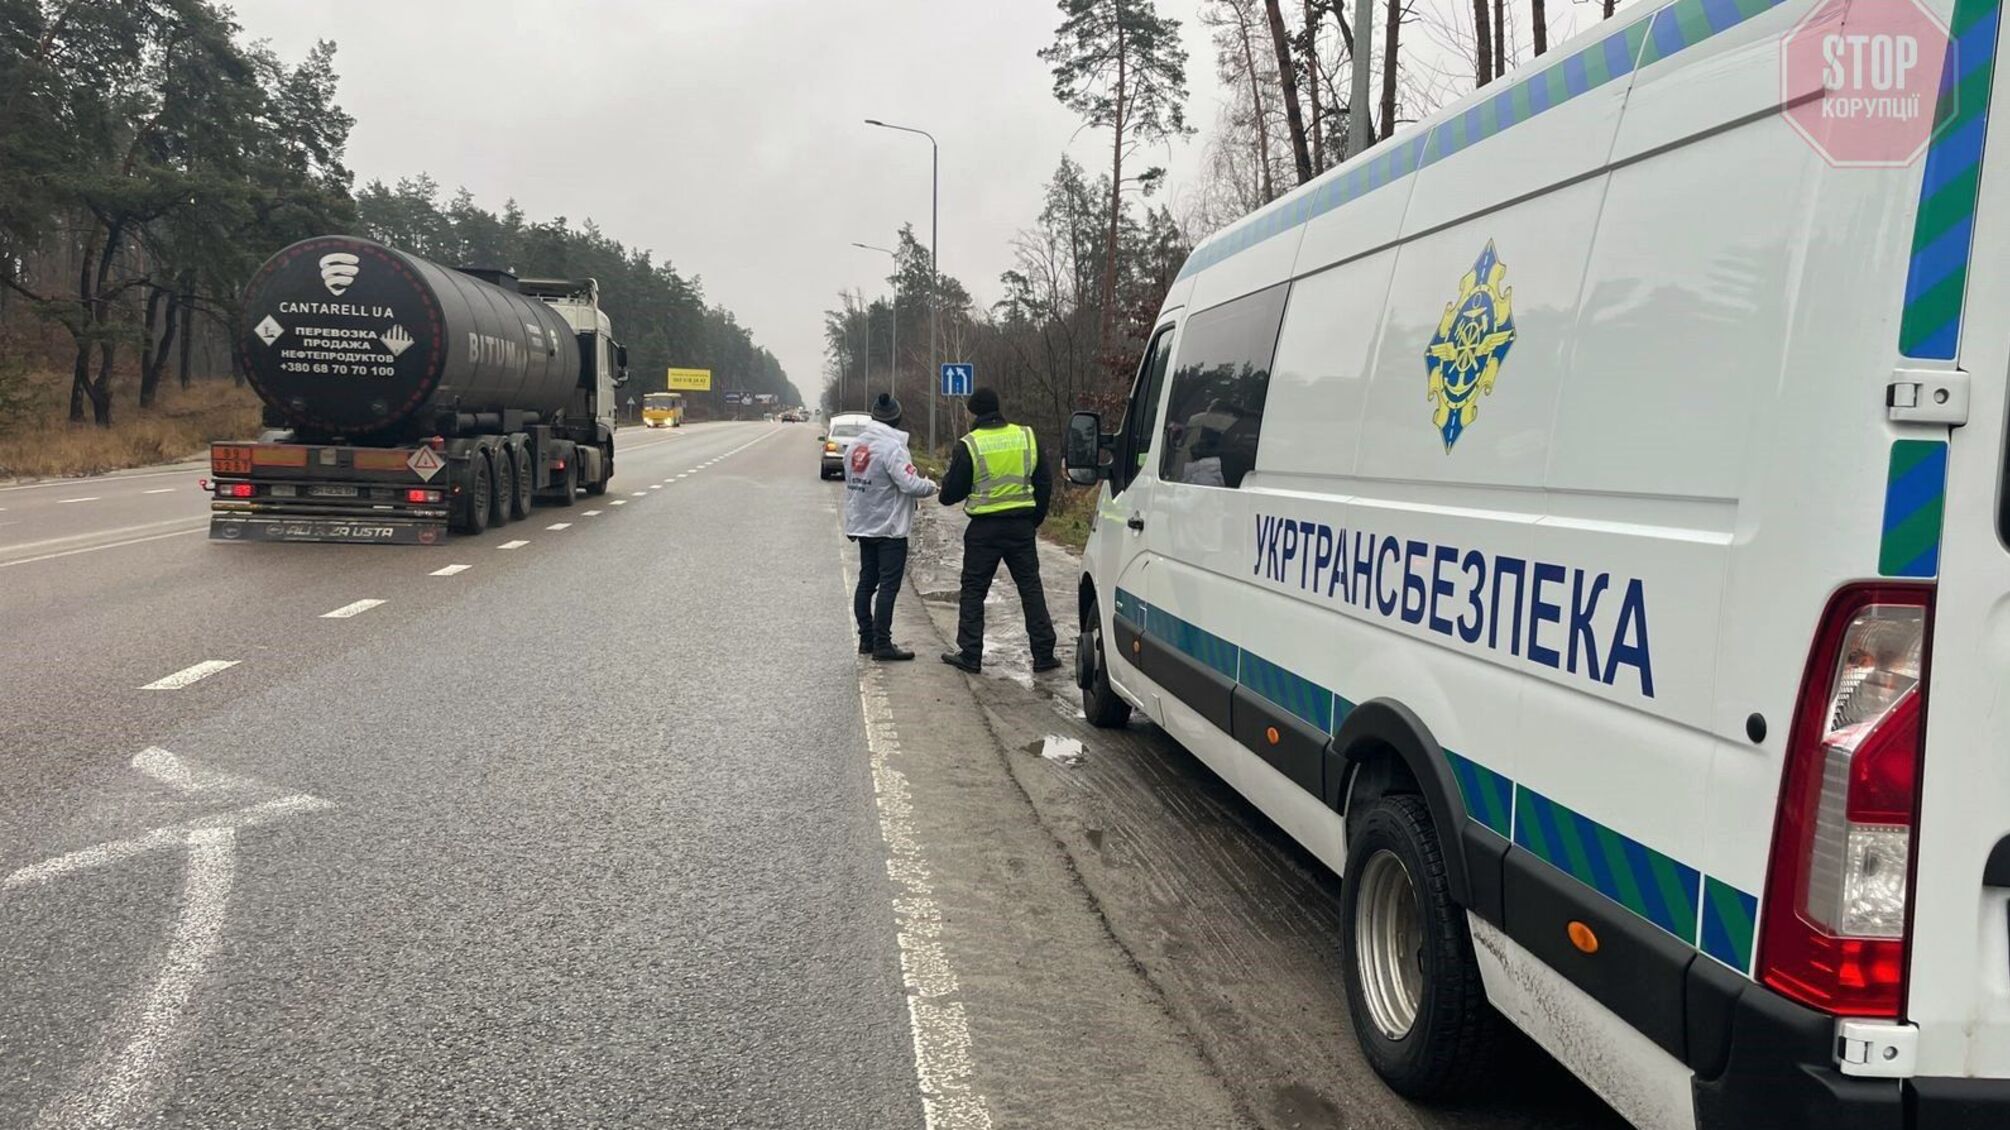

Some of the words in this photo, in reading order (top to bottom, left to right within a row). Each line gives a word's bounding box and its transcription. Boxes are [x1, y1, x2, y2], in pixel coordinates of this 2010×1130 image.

[279, 302, 369, 317] CANTARELL
[295, 327, 378, 340] ПЕРЕВОЗКА
[303, 338, 371, 350] ПРОДАЖА
[281, 350, 394, 363] НЕФТЕПРОДУКТОВ
[280, 362, 310, 373] +380
[313, 363, 329, 374] 68
[331, 364, 348, 375] 70
[351, 365, 367, 375] 70
[371, 366, 395, 377] 100
[352, 526, 394, 538] USTA
[1253, 513, 1655, 699] УКРТРАНСБЕЗПЕКА
